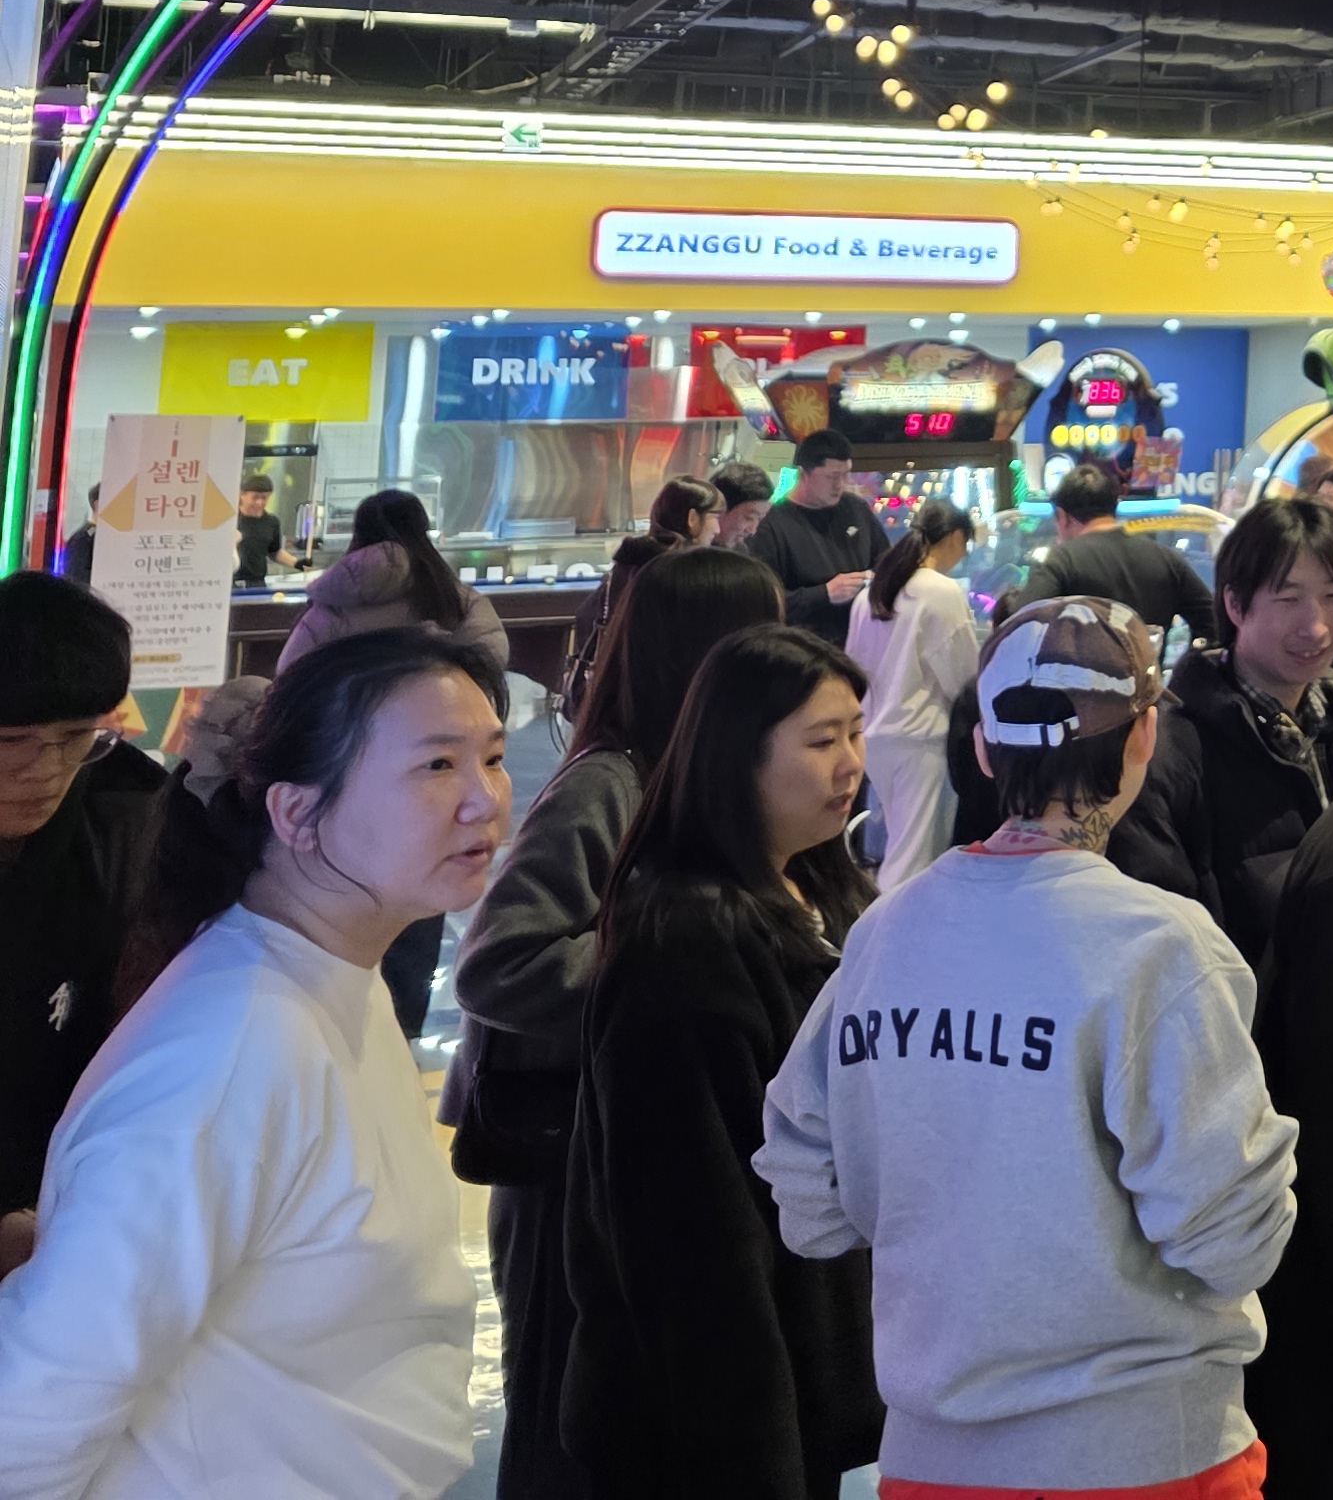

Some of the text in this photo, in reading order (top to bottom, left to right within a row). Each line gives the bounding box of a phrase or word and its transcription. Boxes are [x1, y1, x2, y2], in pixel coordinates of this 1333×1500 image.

[615, 232, 999, 265] ZZANGGU Food & Beverage
[227, 358, 308, 387] EAT
[471, 357, 598, 386] DRINK
[147, 459, 201, 485] 설렌
[144, 493, 197, 519] 타인
